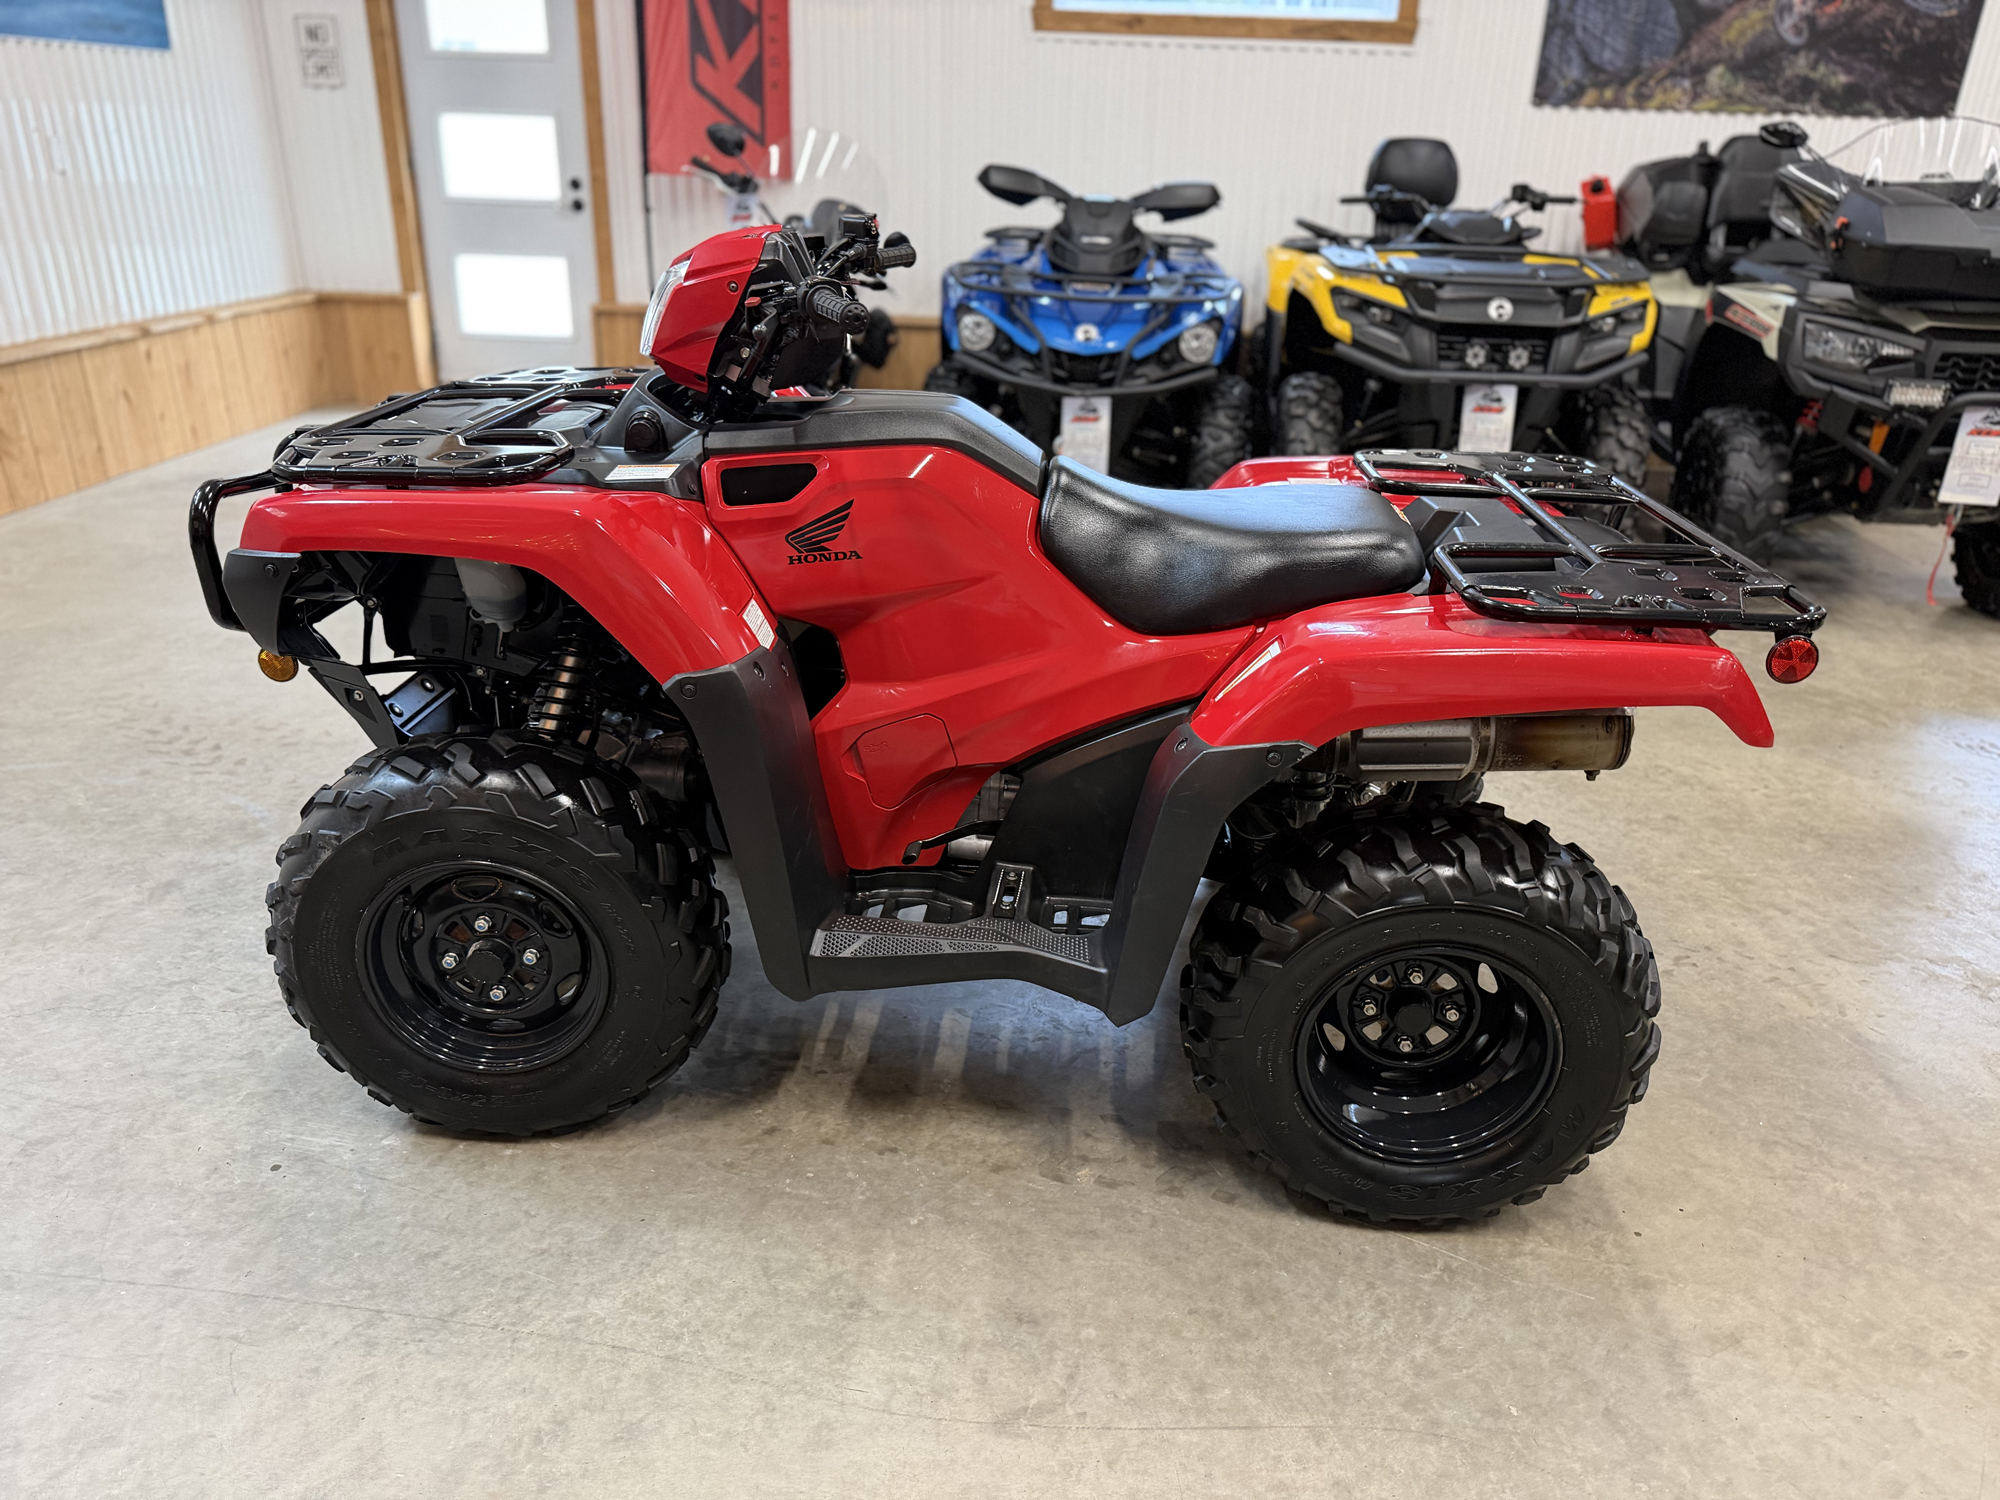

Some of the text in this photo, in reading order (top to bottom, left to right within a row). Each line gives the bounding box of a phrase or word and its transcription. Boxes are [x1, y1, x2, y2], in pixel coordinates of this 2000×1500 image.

[787, 550, 863, 565] HONDA
[372, 827, 598, 893] MAXXIS
[1386, 1102, 1586, 1201] MAXXIS
